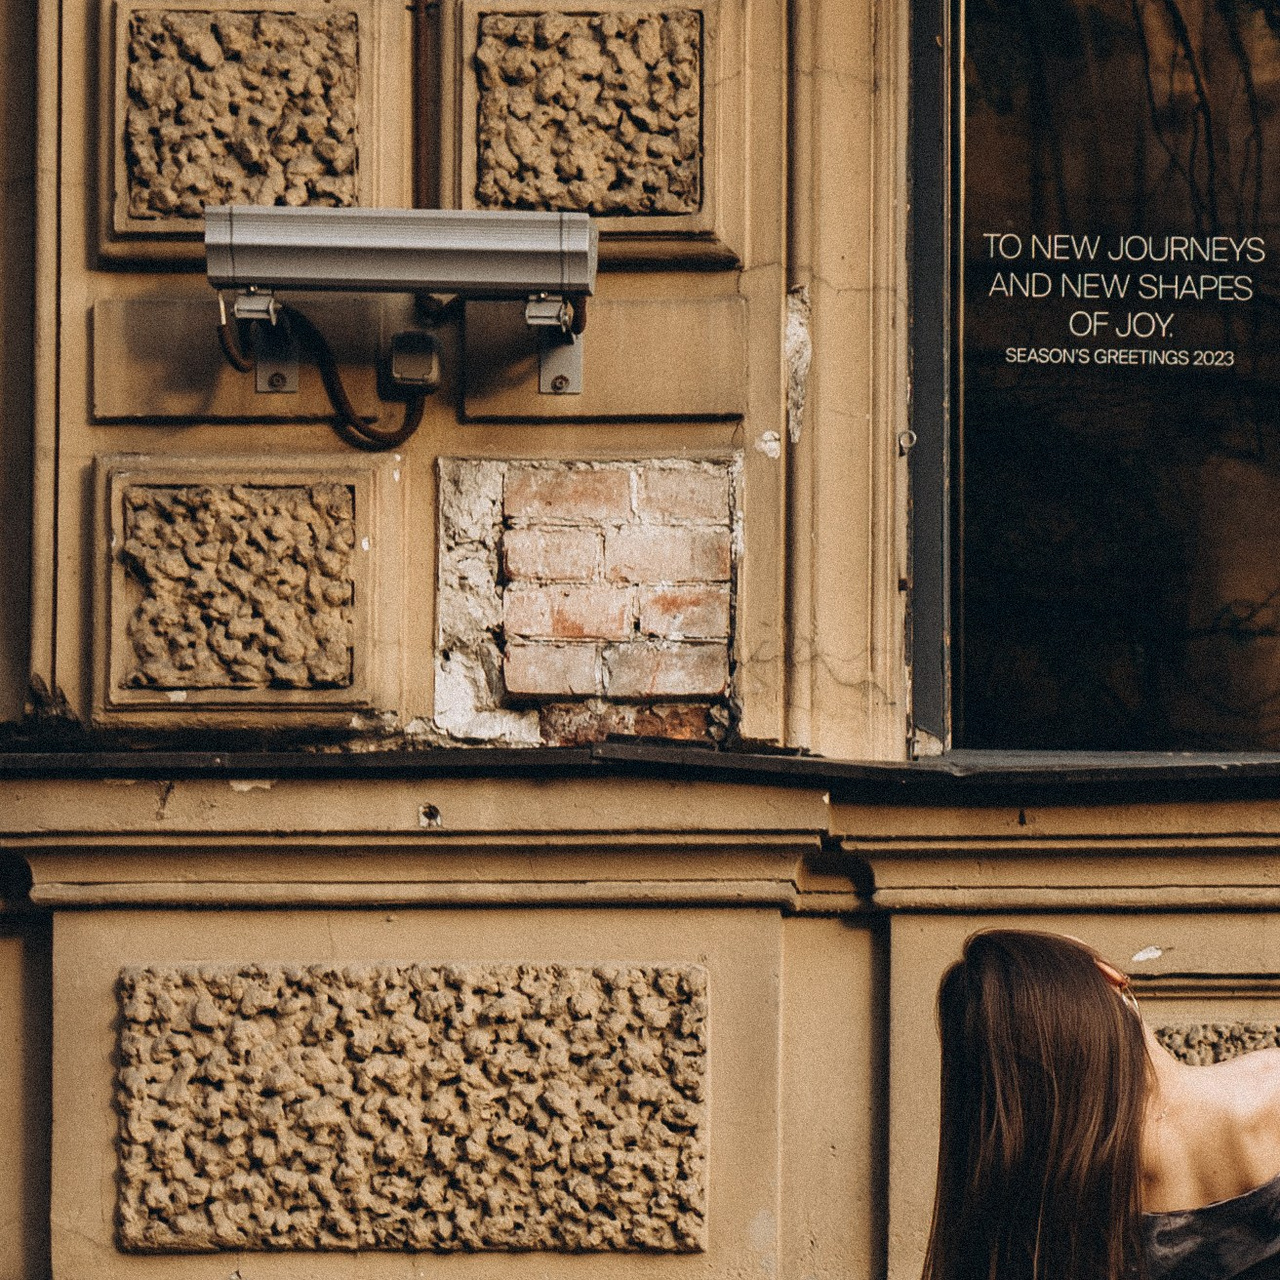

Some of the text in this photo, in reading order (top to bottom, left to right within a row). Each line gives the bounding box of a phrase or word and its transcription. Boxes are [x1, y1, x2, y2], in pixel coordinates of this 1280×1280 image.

[983, 232, 1266, 263] TO NEW JOURNEYS
[988, 272, 1253, 301] AND NEW SHAPES
[1068, 310, 1174, 338] OF JOY.
[1005, 347, 1235, 366] SEASON'S GREETINGS 2023
